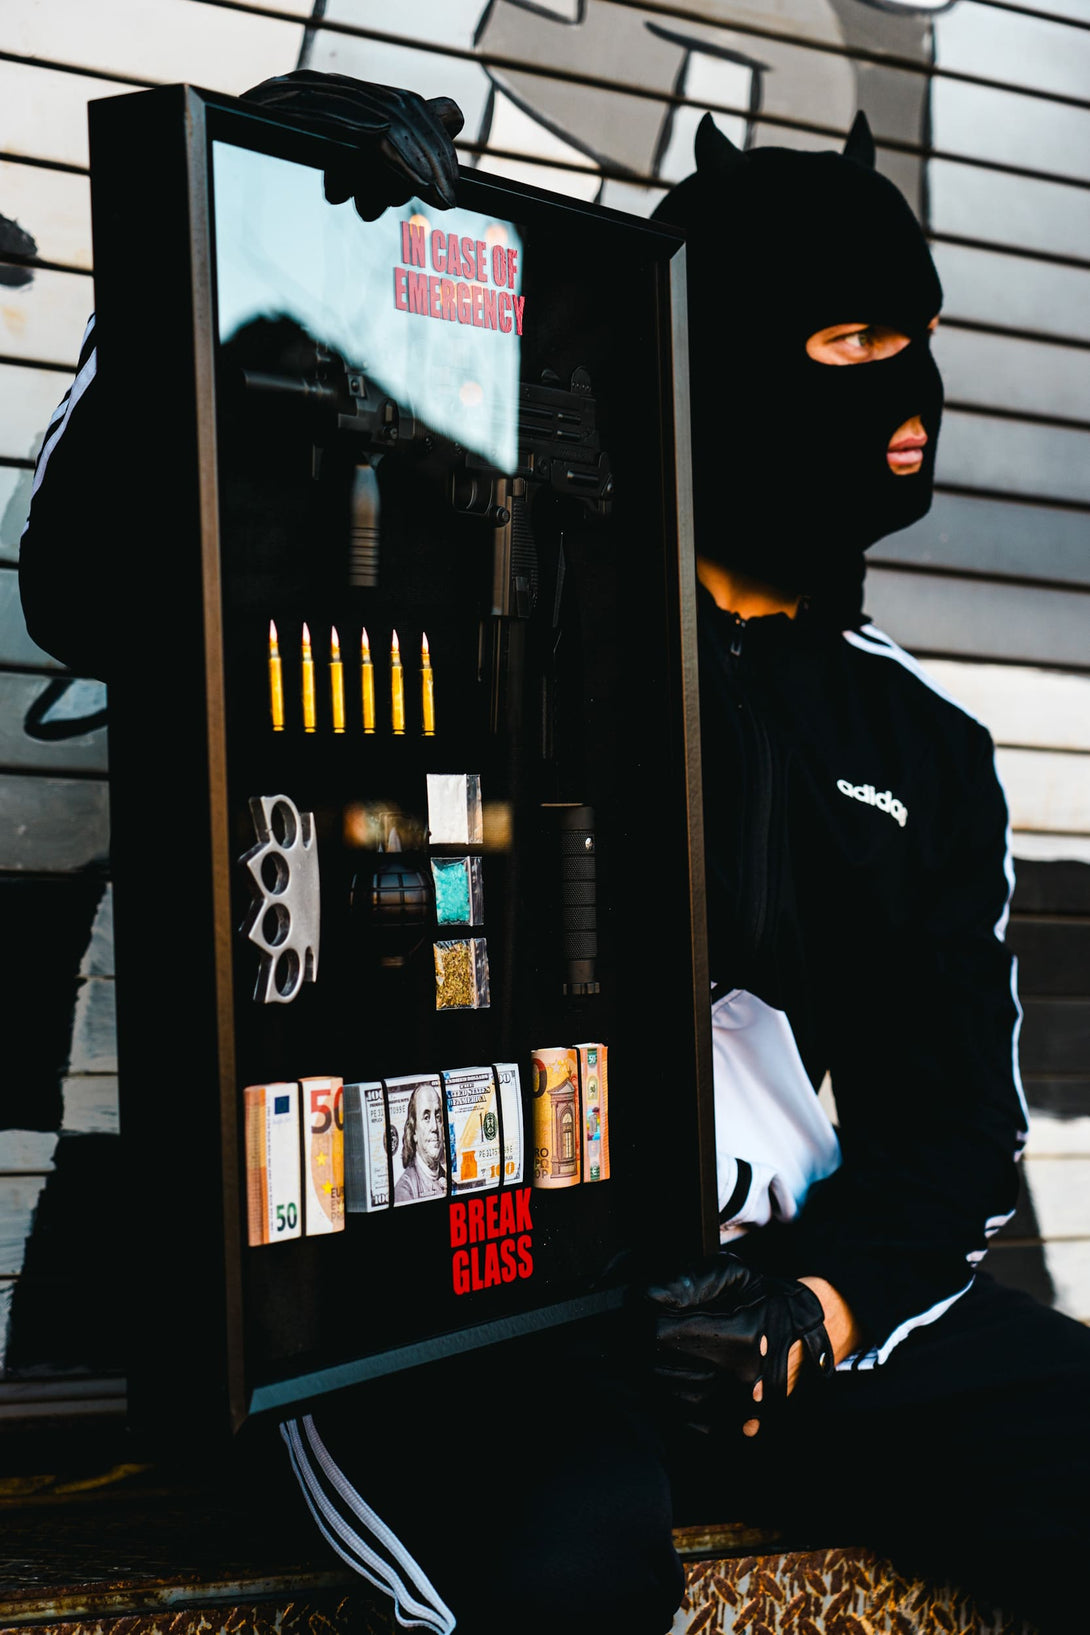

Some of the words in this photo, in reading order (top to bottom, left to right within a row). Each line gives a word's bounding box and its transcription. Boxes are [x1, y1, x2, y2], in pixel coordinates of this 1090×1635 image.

[401, 220, 426, 269] IN
[431, 228, 489, 283] CASE
[492, 244, 518, 290] OF
[394, 266, 526, 336] EMERGENCY
[276, 1202, 298, 1232] 50
[449, 1187, 533, 1248] BREAK
[452, 1234, 534, 1295] GLASS
